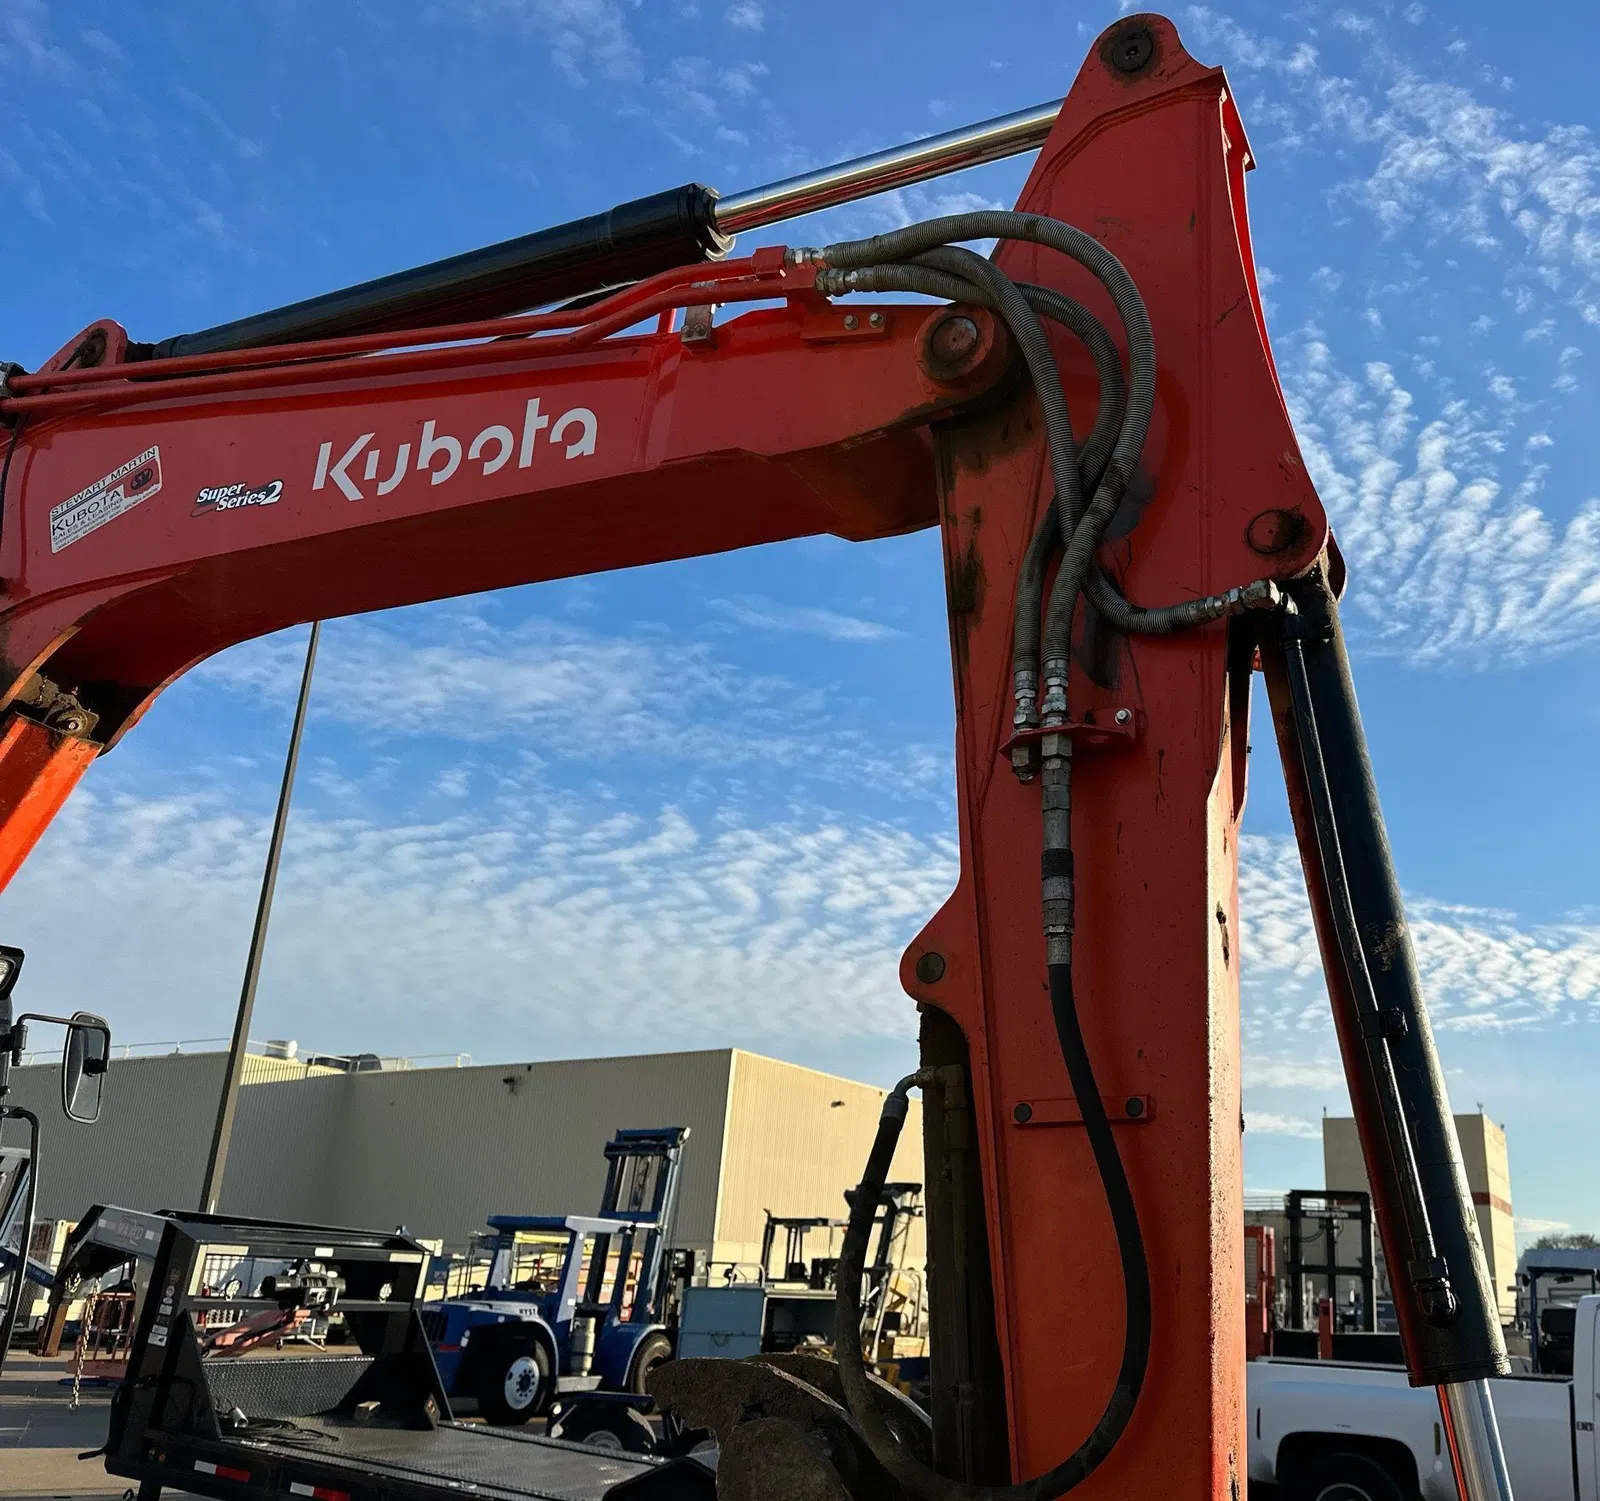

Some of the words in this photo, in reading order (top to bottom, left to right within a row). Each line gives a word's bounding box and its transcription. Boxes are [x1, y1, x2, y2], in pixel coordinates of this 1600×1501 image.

[312, 397, 598, 501] Kubota
[52, 479, 106, 515] STEWART
[110, 448, 156, 480] MARTIN
[197, 482, 245, 503] Super
[52, 490, 121, 536] KUBOTA
[53, 524, 79, 542] SALES
[87, 498, 123, 522] LEASING
